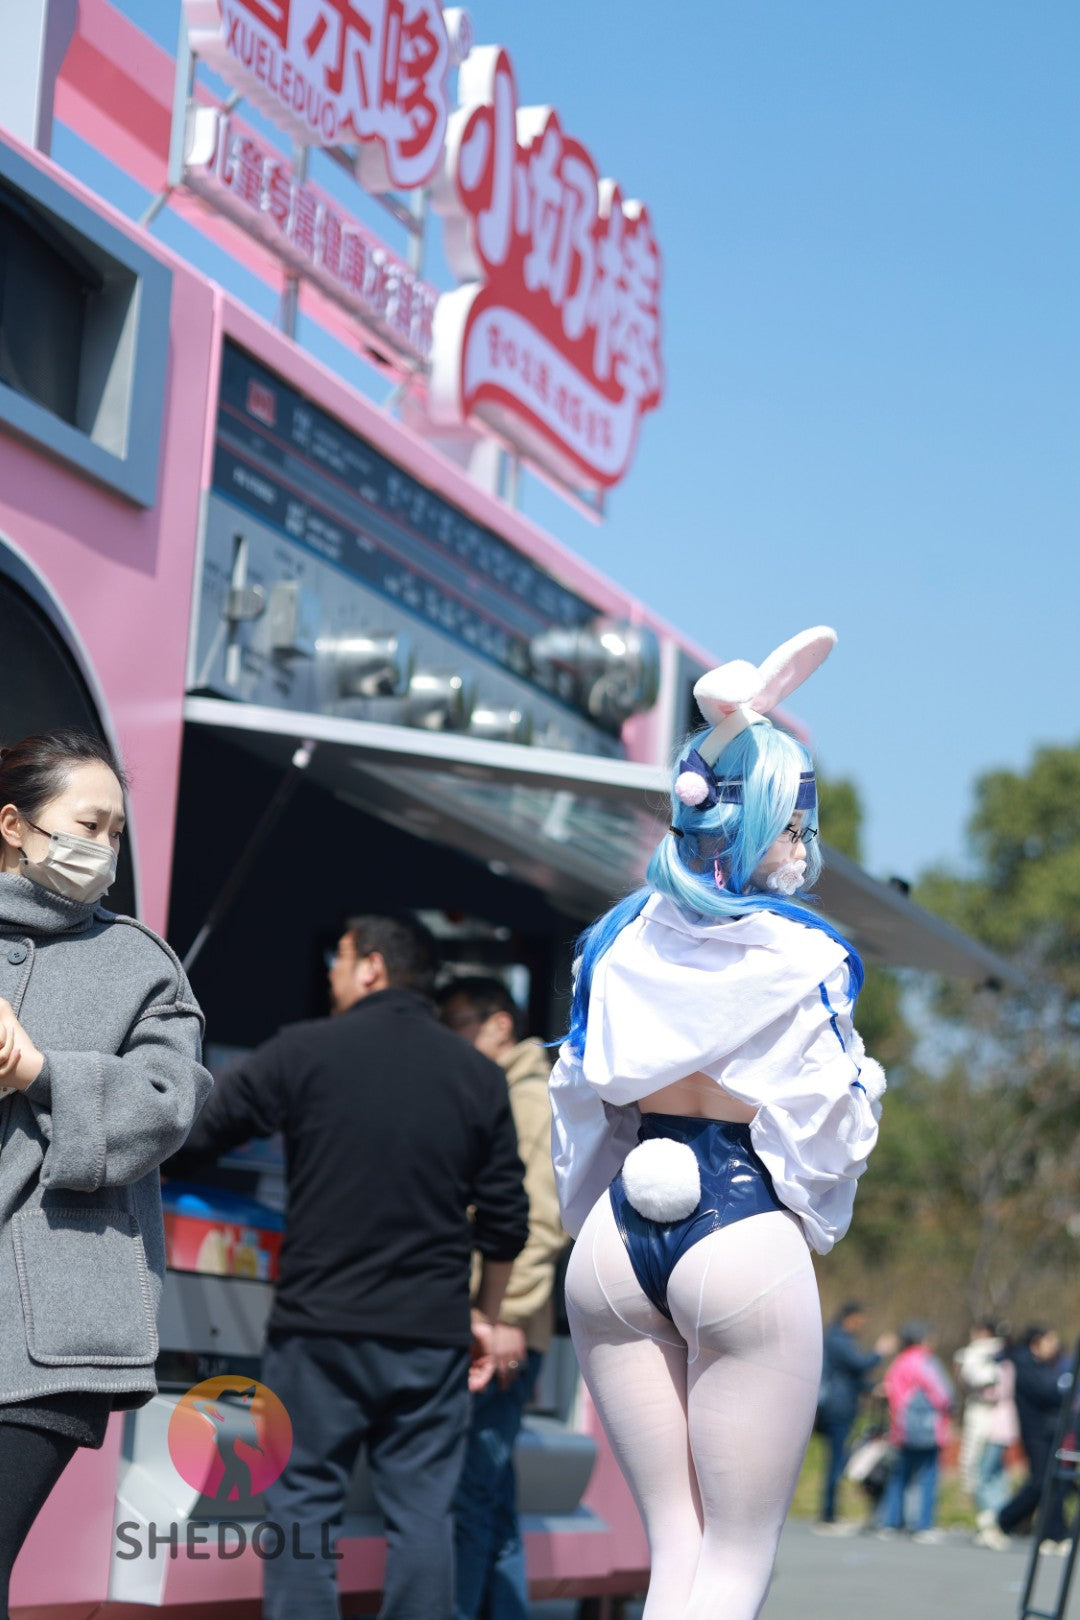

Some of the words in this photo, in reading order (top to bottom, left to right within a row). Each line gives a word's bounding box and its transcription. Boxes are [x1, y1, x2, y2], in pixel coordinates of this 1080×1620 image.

[227, 10, 337, 139] XUELEDUO
[459, 71, 663, 405] 小奶棒
